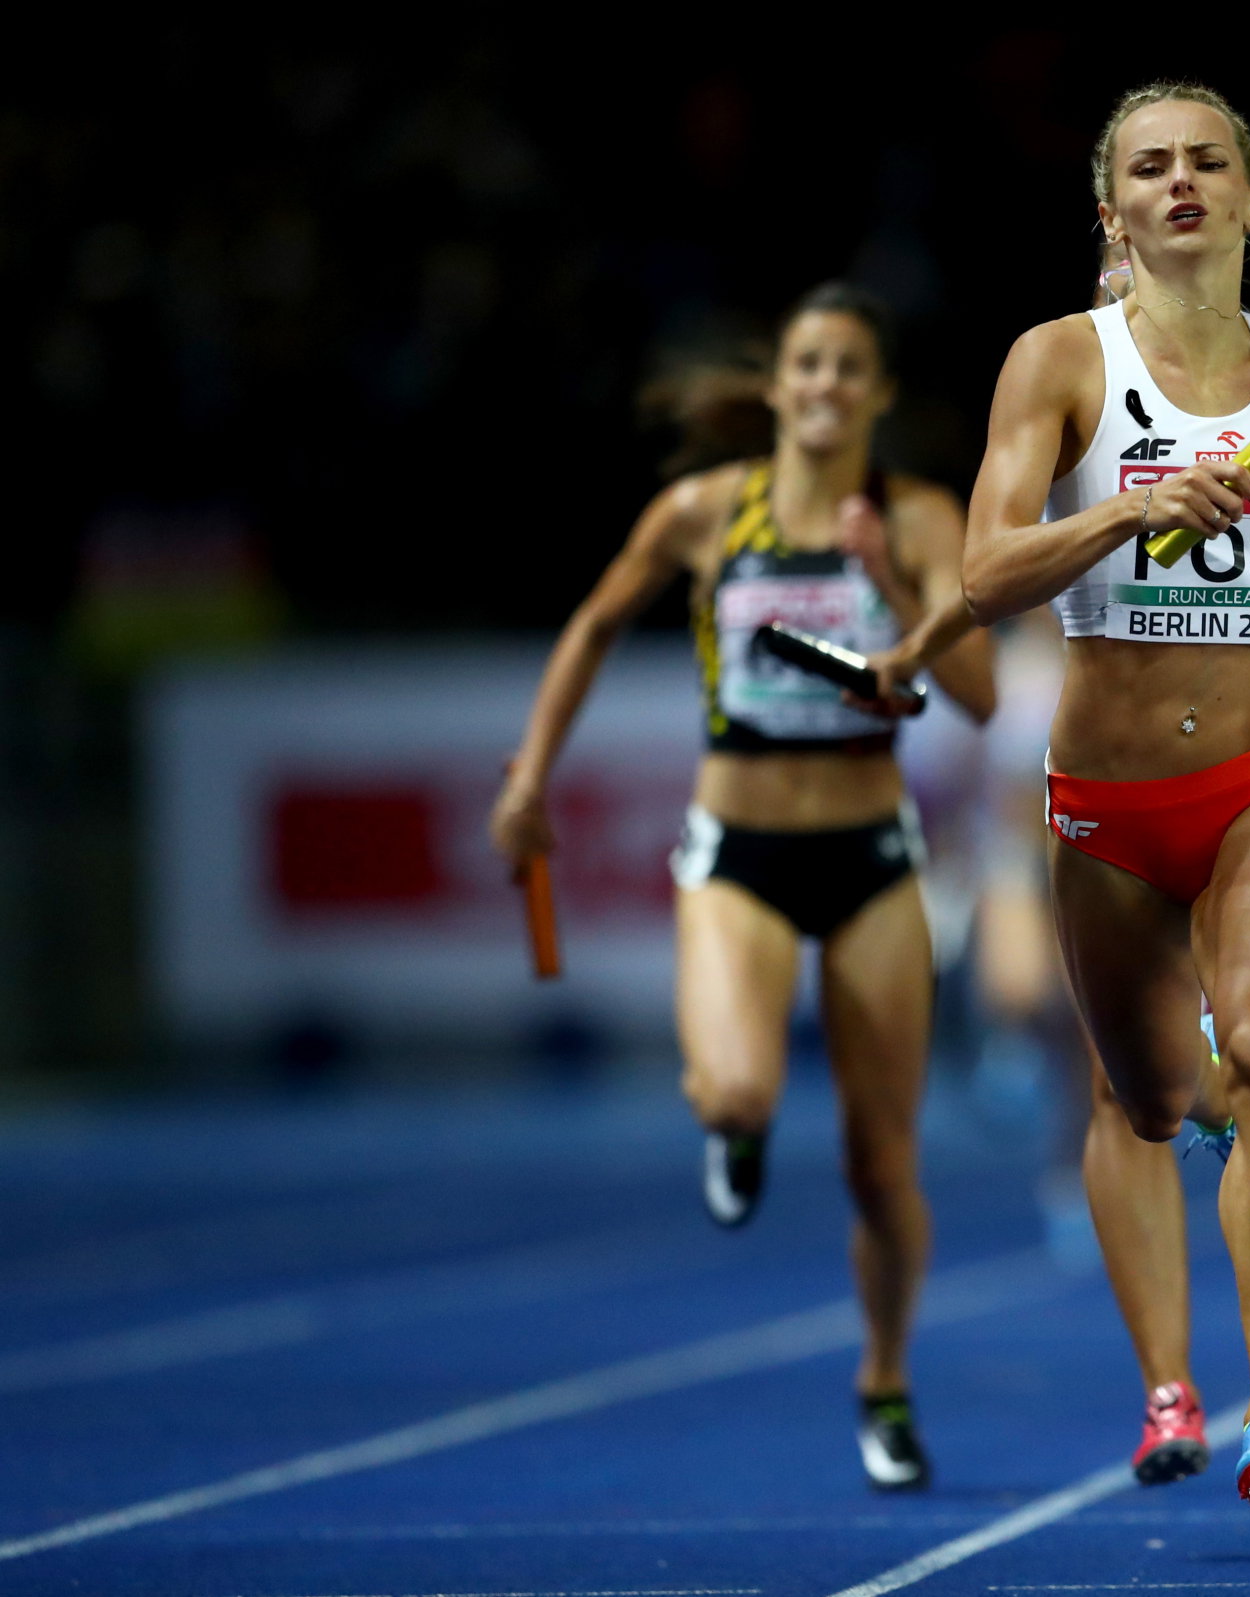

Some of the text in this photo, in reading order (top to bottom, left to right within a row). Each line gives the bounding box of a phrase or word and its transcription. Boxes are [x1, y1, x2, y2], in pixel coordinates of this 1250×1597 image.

[1119, 437, 1177, 461] 4F
[1158, 589, 1163, 604] I
[1168, 589, 1206, 604] RUN
[1128, 610, 1229, 638] BERLIN
